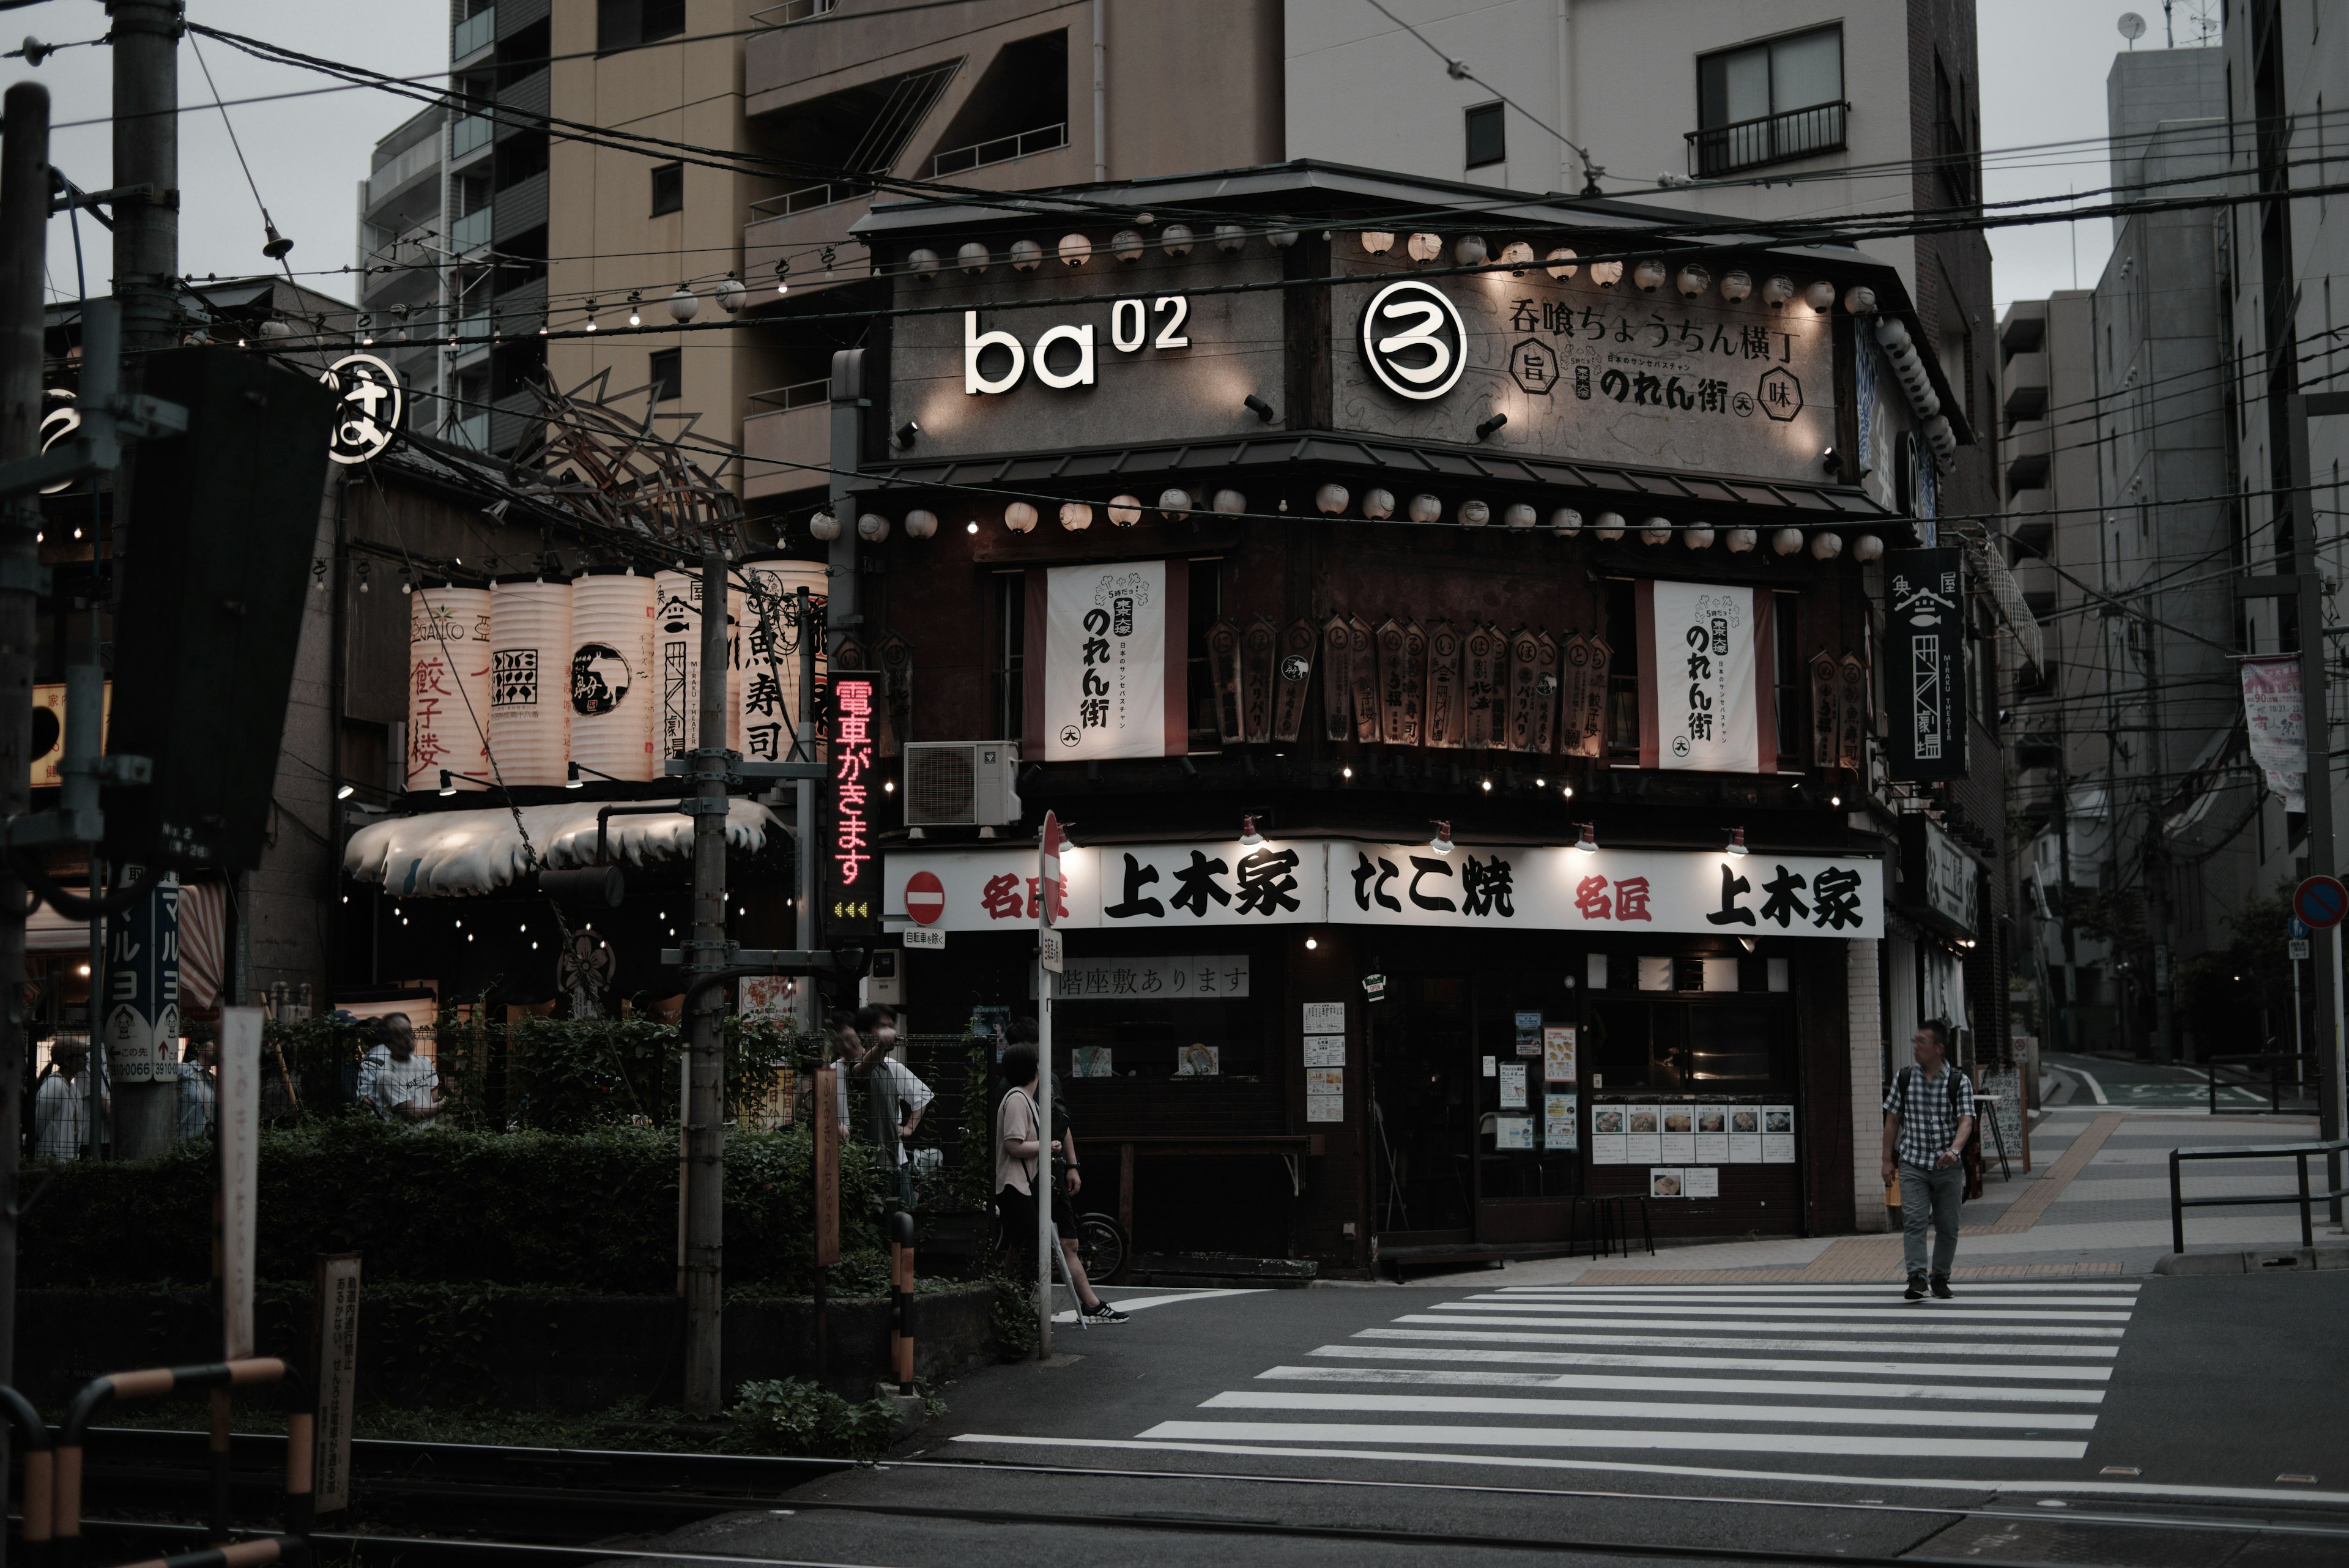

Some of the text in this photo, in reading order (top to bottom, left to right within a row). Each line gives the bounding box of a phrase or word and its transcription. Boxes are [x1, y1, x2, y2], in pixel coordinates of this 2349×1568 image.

[965, 296, 1190, 395] ba 02
[1509, 299, 1800, 364] 呑喰ちょうちん横丁
[1524, 355, 1543, 381] 旨
[1578, 368, 1589, 398] 東京大塚
[1607, 355, 1690, 371] 日本のサンセバスチャン
[1601, 369, 1727, 414] のれん街
[1769, 382, 1791, 408] 味
[1115, 600, 1132, 634] 東京大塚
[1713, 620, 1727, 653] 東京大塚
[1080, 608, 1110, 729] のれん街
[1687, 626, 1712, 741] のれん街
[1515, 685, 1531, 735] パリパリ
[1718, 661, 1727, 743] 日本のサンセバスチャン
[1843, 705, 1860, 761] 魚寿司
[836, 680, 872, 885] 電車がきます
[162, 823, 193, 841] No.2
[1104, 848, 1301, 918] 上木家
[1353, 851, 1515, 918] たこ焼
[1574, 874, 1652, 923] 名匠
[1705, 861, 1865, 931] 上木家
[161, 892, 178, 1000] マルヨ
[907, 932, 943, 944] 自転車を除く
[1037, 967, 1247, 996] 階座敷あります
[122, 1047, 148, 1058] この先
[344, 1277, 357, 1370] 軌道内通行禁止
